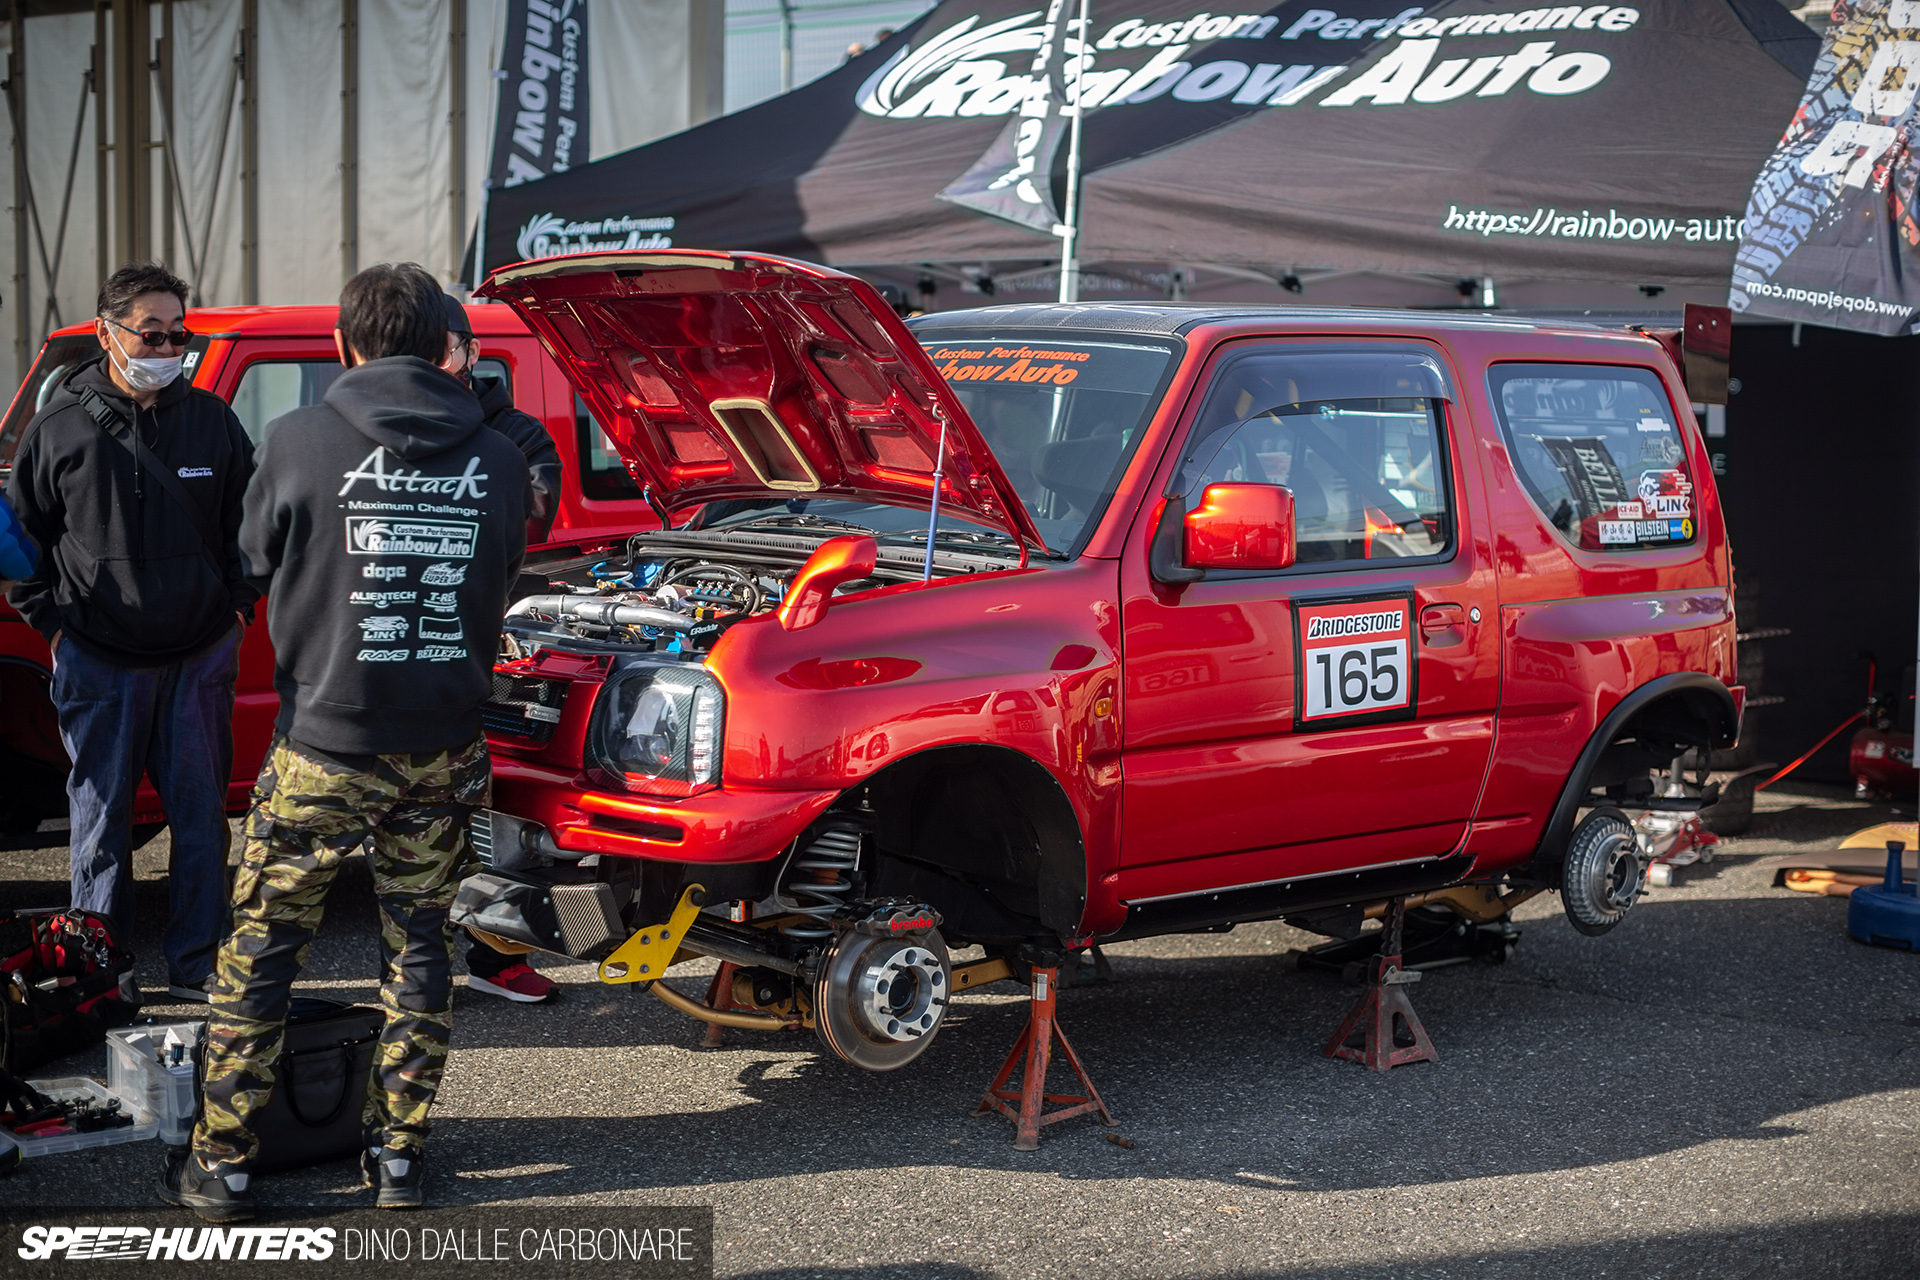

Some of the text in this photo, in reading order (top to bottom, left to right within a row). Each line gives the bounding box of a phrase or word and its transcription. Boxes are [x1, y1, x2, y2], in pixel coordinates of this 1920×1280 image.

[1096, 5, 1640, 49] Custom Performance
[559, 18, 582, 111] Custom
[1319, 38, 1612, 106] Auto
[512, 0, 563, 157] inbow
[563, 215, 675, 237] Custom Performance
[934, 346, 1090, 363] Custom Performance
[994, 359, 1079, 385] Auto
[338, 446, 488, 500] Attack
[348, 501, 414, 512] Maximum
[417, 503, 479, 517] Challenge
[396, 525, 470, 538] Custom Performance
[1635, 519, 1670, 537] BILSTEIN
[367, 534, 471, 556] Rainbow Auto
[362, 562, 407, 582] dope
[423, 575, 449, 583] SUPER
[350, 591, 418, 600] ALIENTECH
[690, 624, 718, 636] GReddy
[1308, 612, 1402, 638] BRIDGESTONE
[357, 649, 410, 661] RAYS
[416, 648, 467, 659] BELLEZZA
[1316, 646, 1399, 709] 165
[891, 916, 933, 931] brembo
